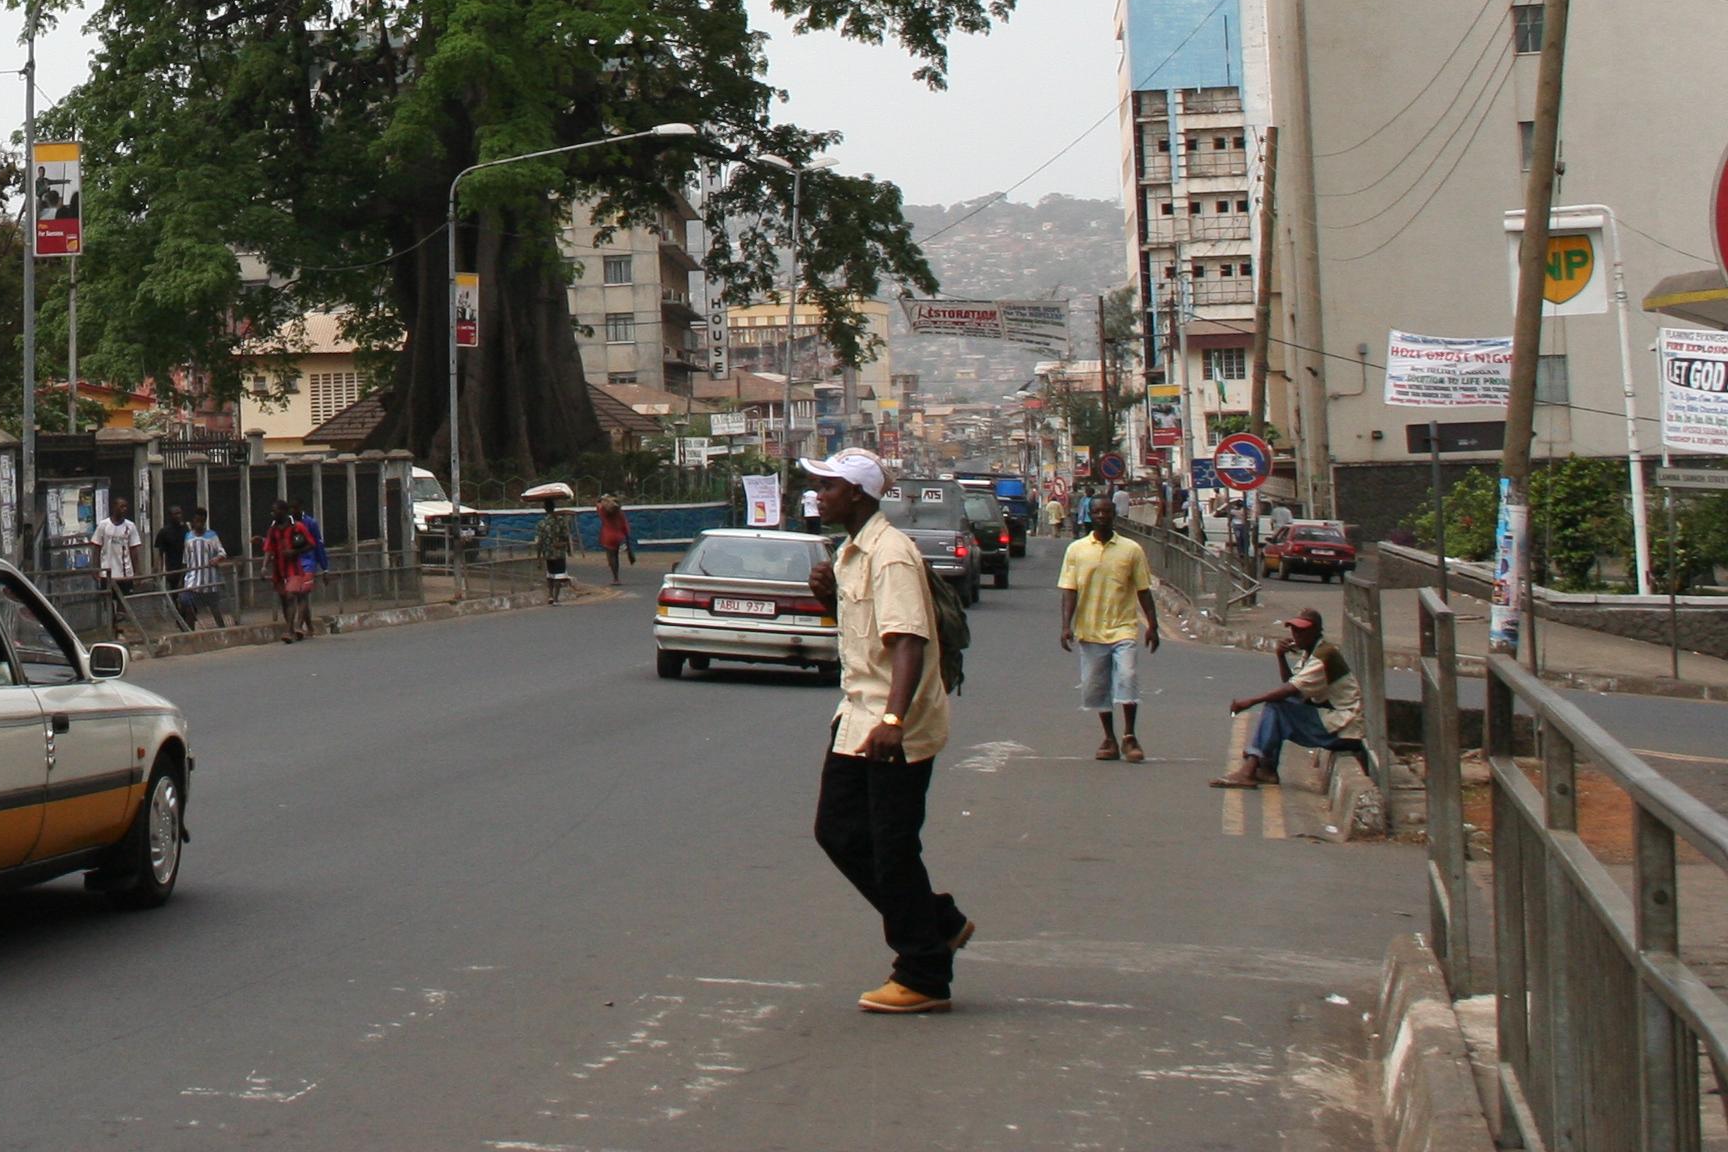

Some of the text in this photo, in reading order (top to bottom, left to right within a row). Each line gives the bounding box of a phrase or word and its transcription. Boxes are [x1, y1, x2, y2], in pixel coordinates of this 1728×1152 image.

[711, 298, 724, 373] HOUSE
[1669, 360, 1726, 391] LET GOD
[923, 490, 941, 499] ATS
[719, 600, 740, 611] ABU
